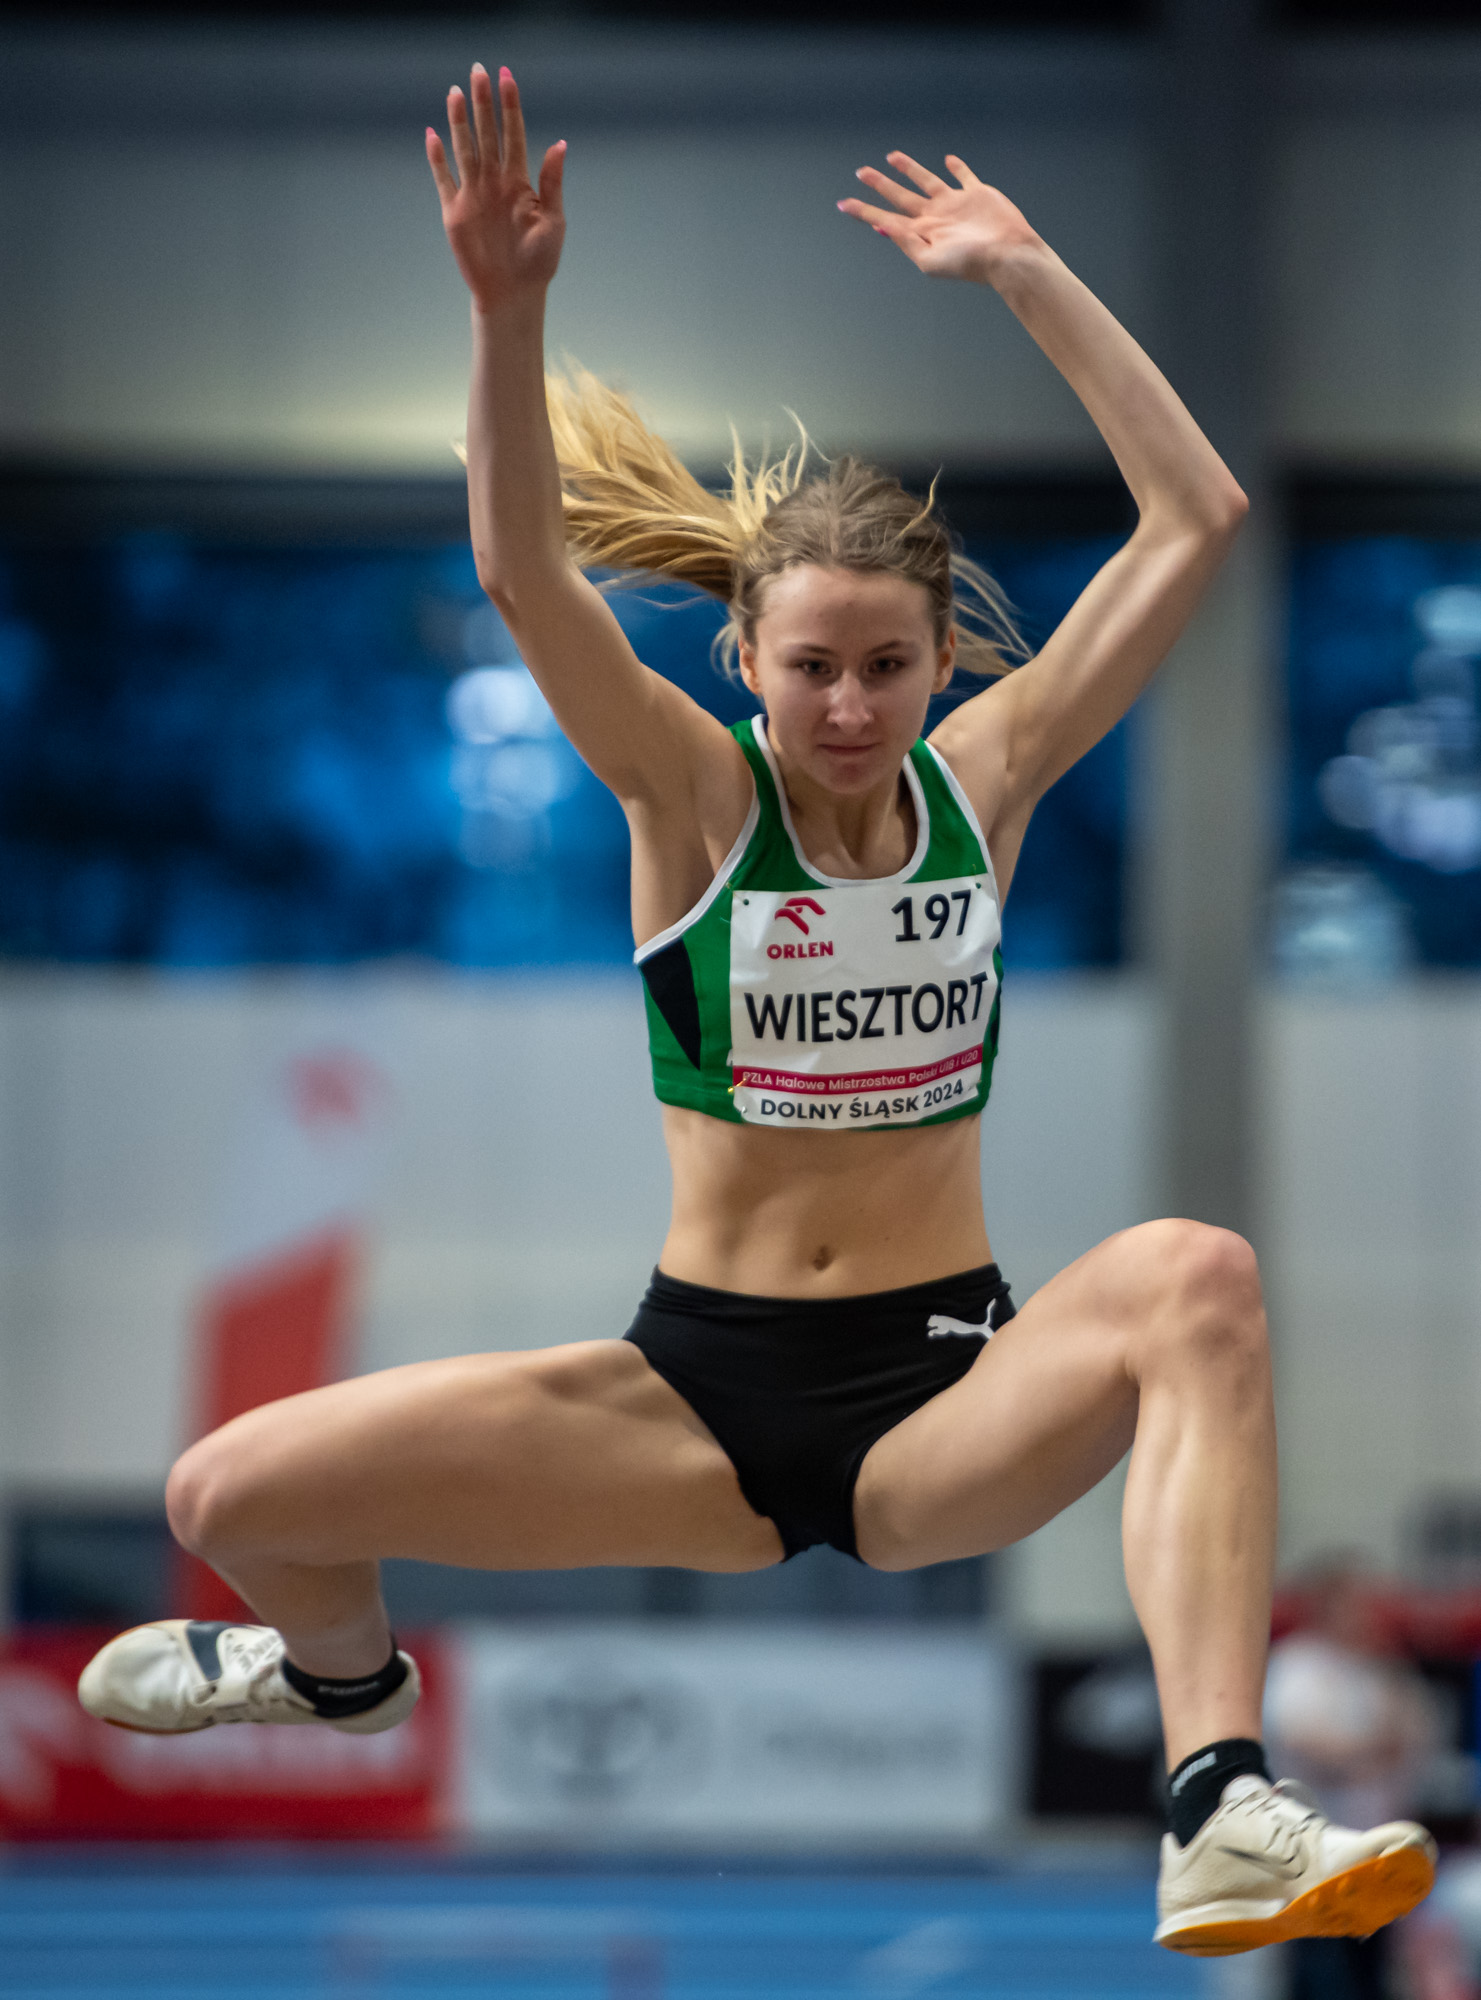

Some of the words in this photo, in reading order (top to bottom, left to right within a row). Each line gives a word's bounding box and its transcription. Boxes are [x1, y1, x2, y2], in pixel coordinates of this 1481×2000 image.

[891, 889, 971, 942] 197
[767, 941, 833, 959] ORLEN
[744, 972, 988, 1043] WIESZTORT
[743, 1071, 772, 1085] PZLA
[775, 1077, 825, 1090] Halowe
[829, 1075, 905, 1091] Mistrzostwa
[909, 1068, 937, 1083] Polski
[961, 1050, 978, 1065] U20
[761, 1099, 843, 1119] DOLNY
[850, 1097, 919, 1118] ŚLĄSK
[924, 1080, 963, 1106] 2024
